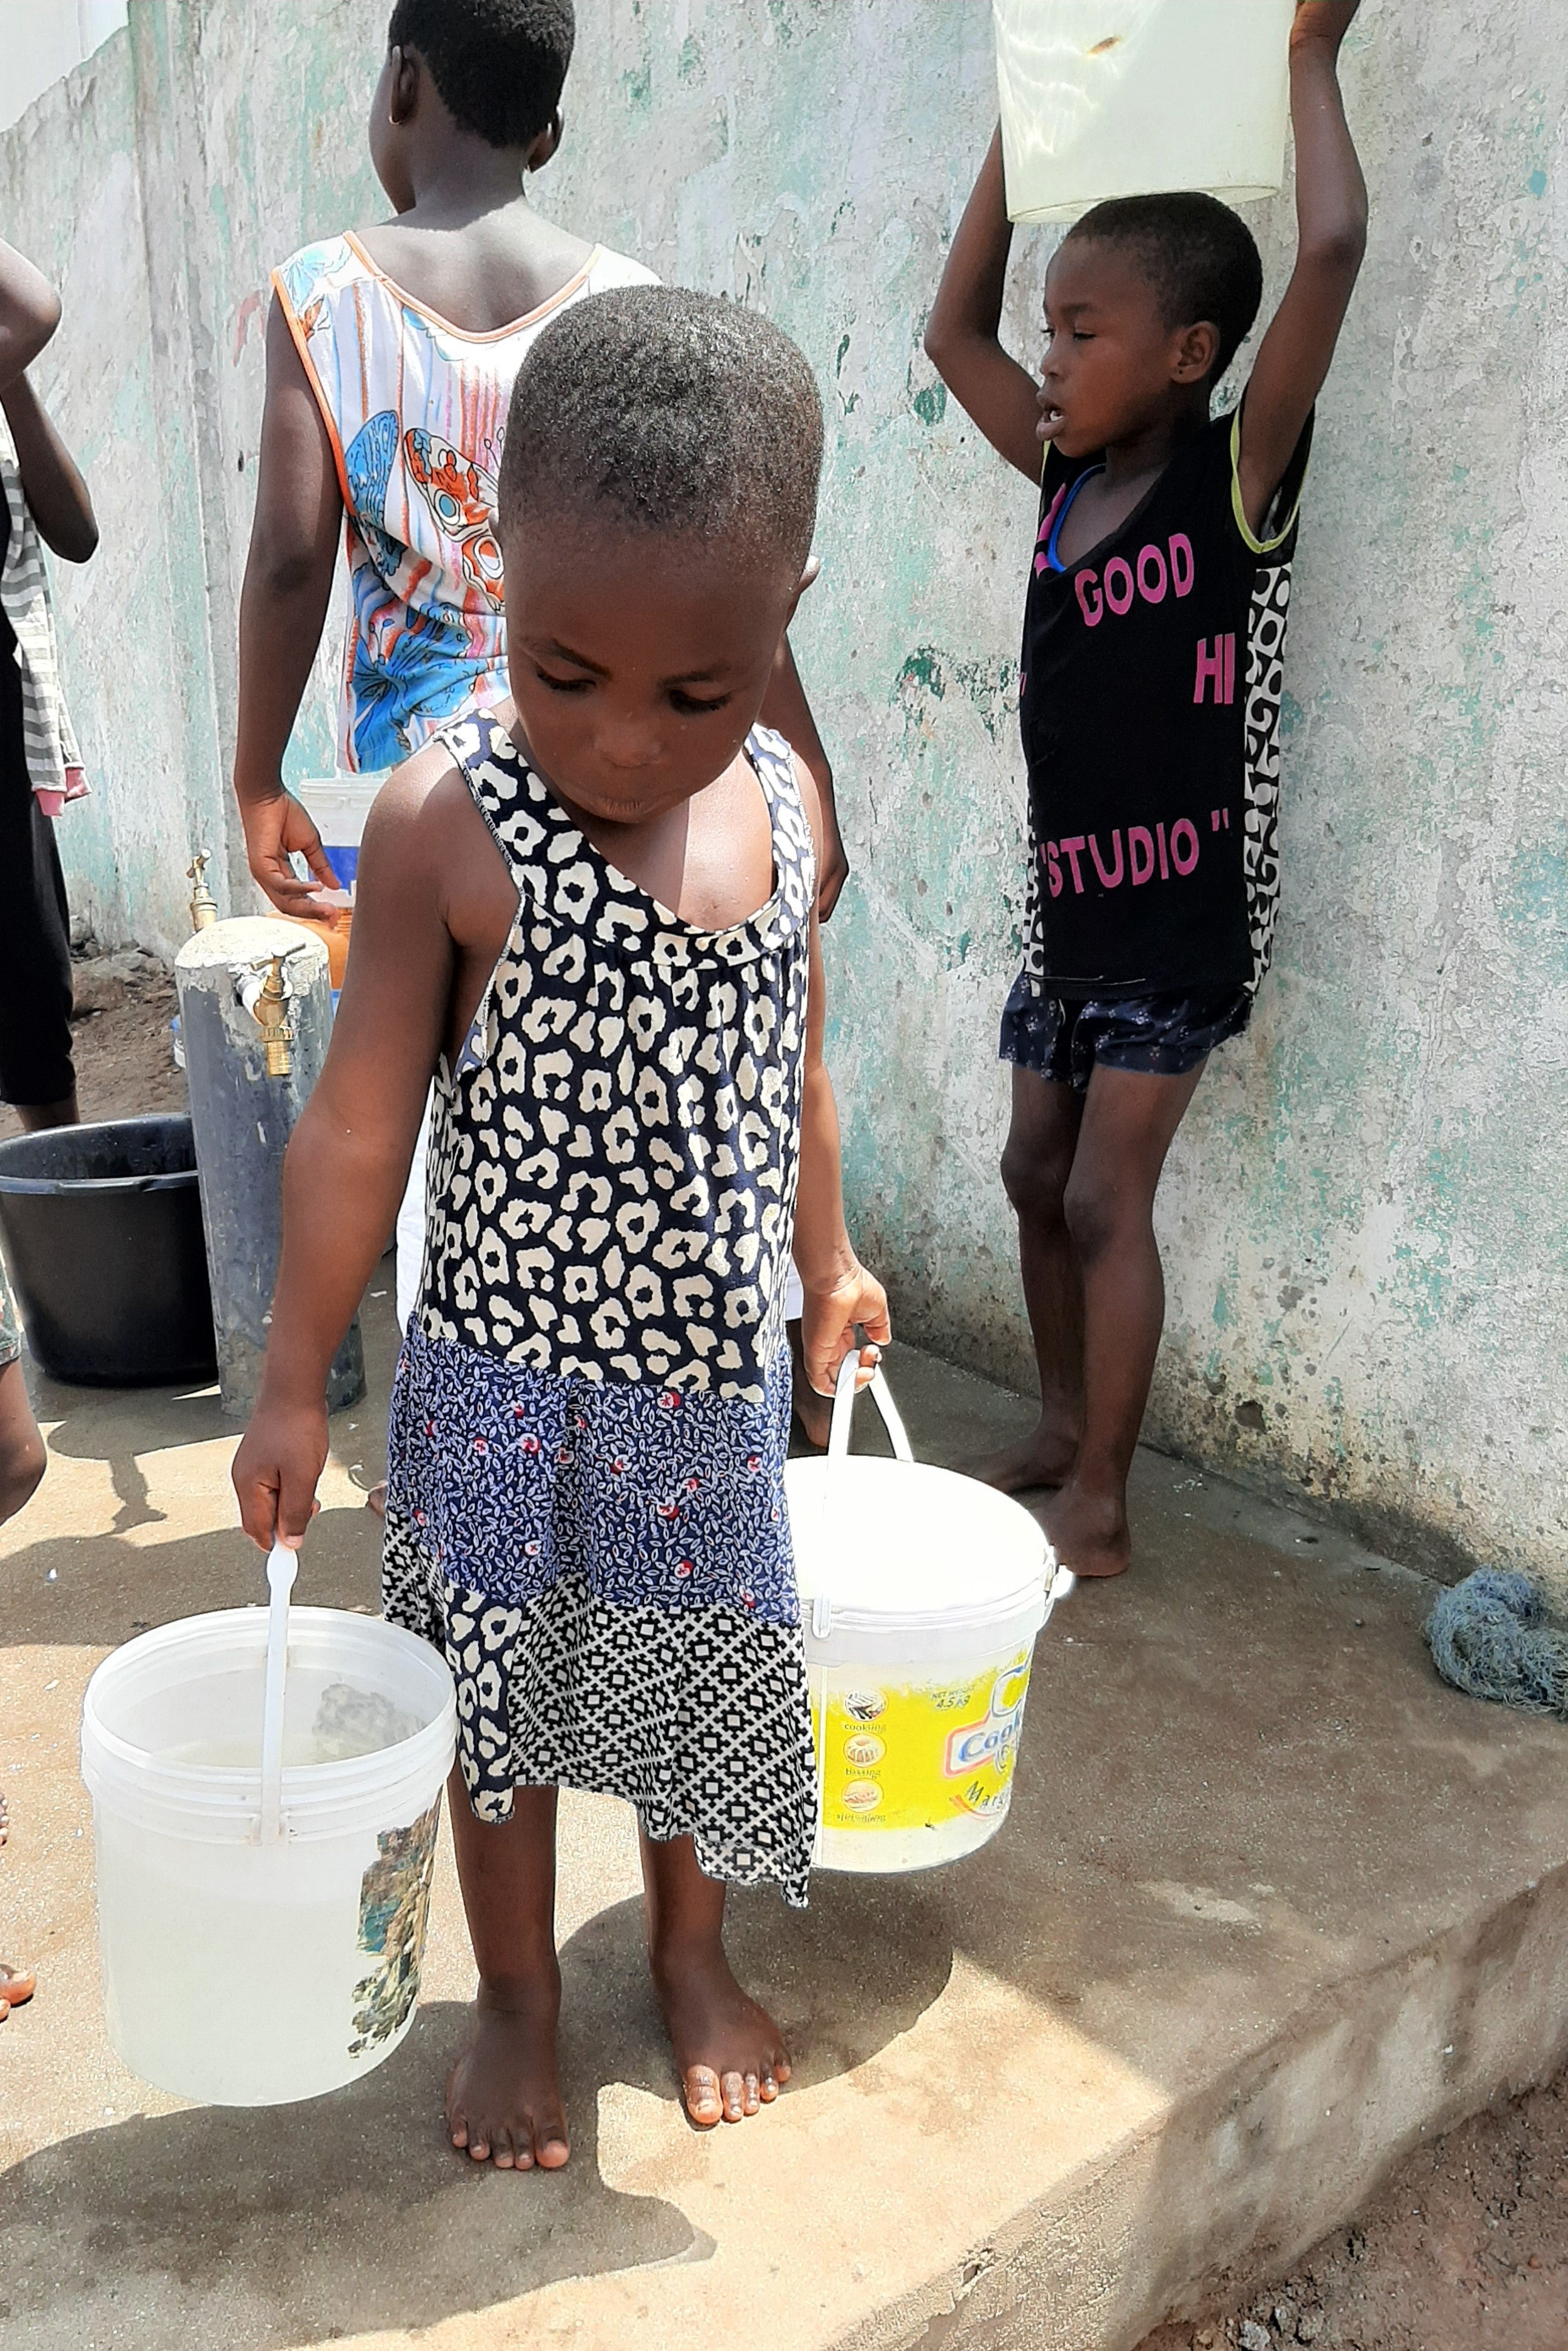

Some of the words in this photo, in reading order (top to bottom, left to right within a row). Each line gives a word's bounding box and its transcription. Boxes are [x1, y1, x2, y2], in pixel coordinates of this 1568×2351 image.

[1074, 533, 1194, 626] GOOD
[1193, 632, 1236, 705] HI
[845, 1723, 887, 1734] cooking
